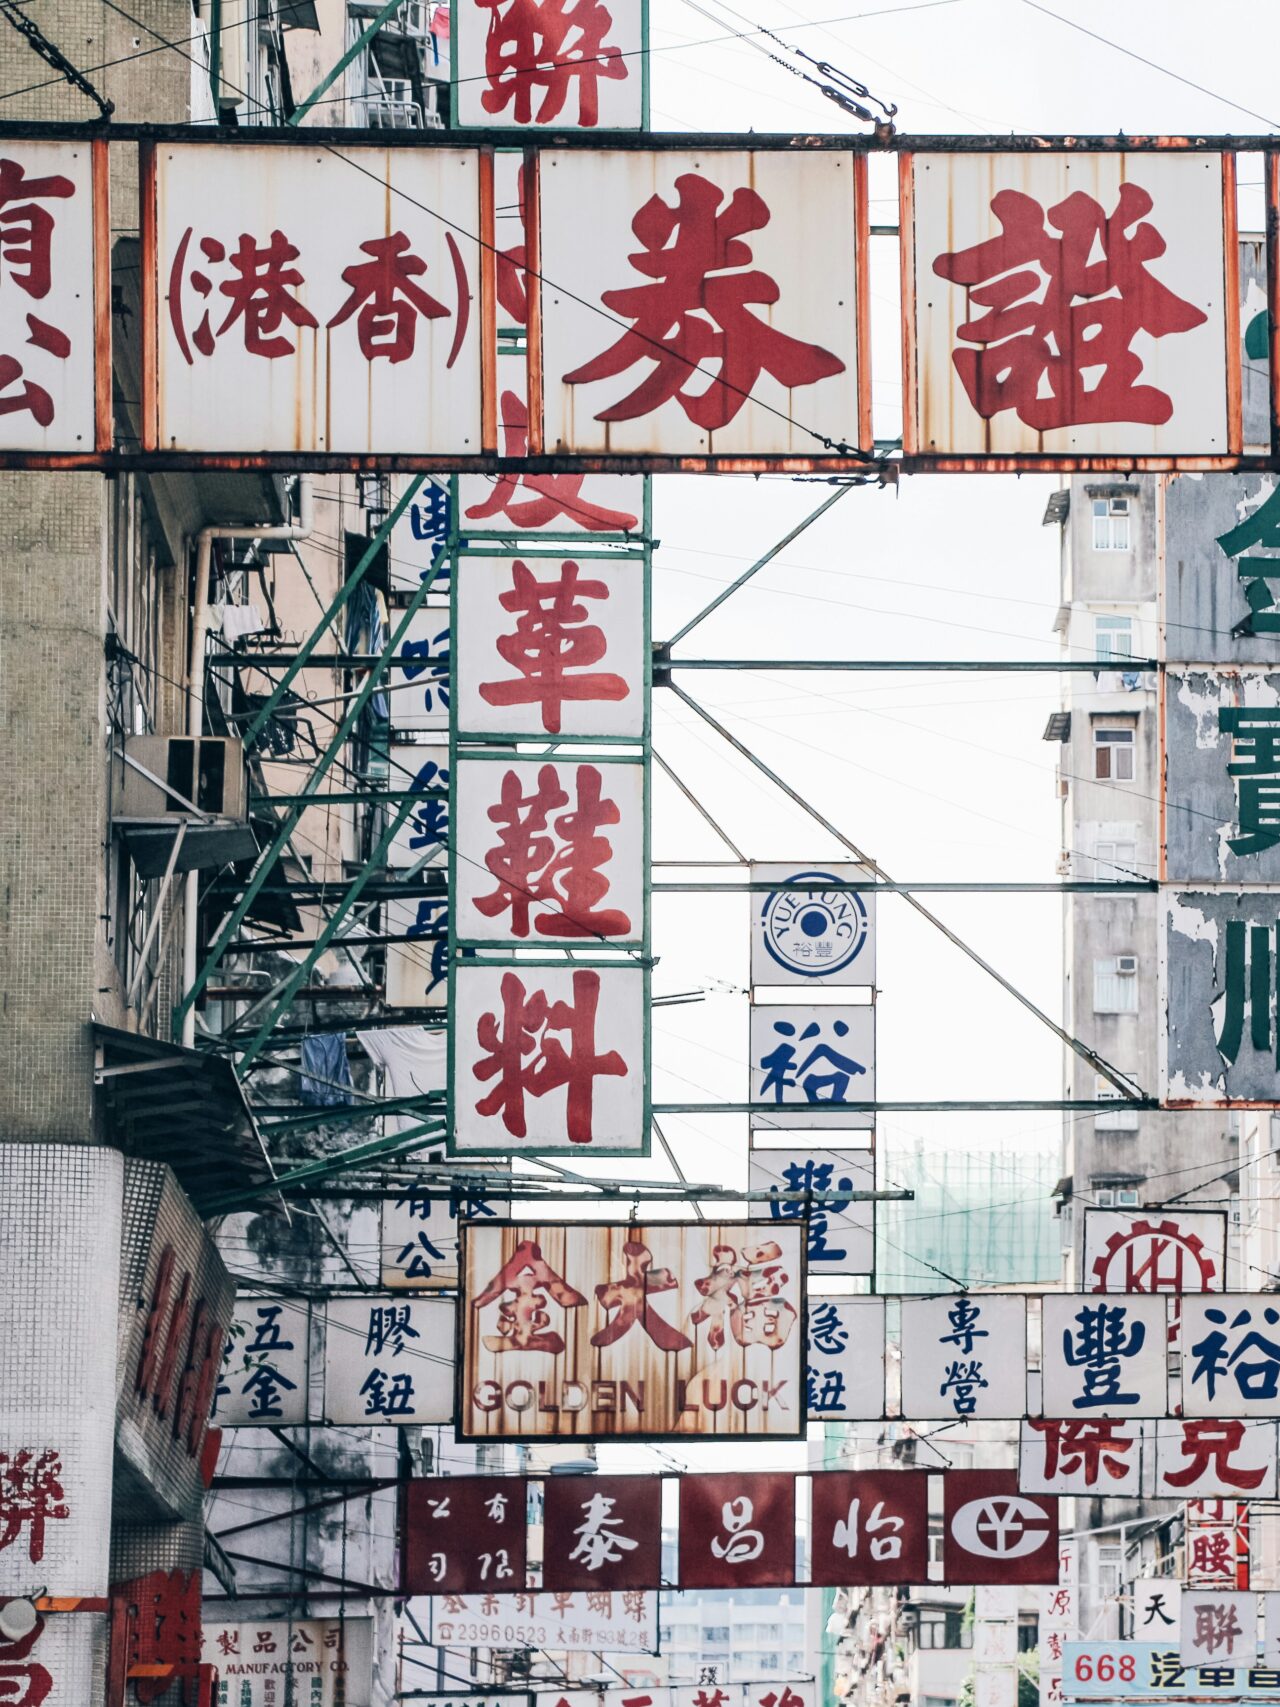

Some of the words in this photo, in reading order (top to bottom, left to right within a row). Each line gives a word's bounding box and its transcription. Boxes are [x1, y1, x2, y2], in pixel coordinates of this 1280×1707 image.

[774, 893, 800, 939] YUE
[807, 890, 853, 939] UNG
[760, 1020, 867, 1260] 裕豐
[472, 1240, 797, 1353] 金大福
[242, 1305, 297, 1417] 五金
[360, 1304, 418, 1417] 膠鈕
[473, 1379, 645, 1412] GOLDEN
[678, 1379, 790, 1412] LUCK
[939, 1299, 989, 1414] 專營
[1075, 1655, 1136, 1683] 668
